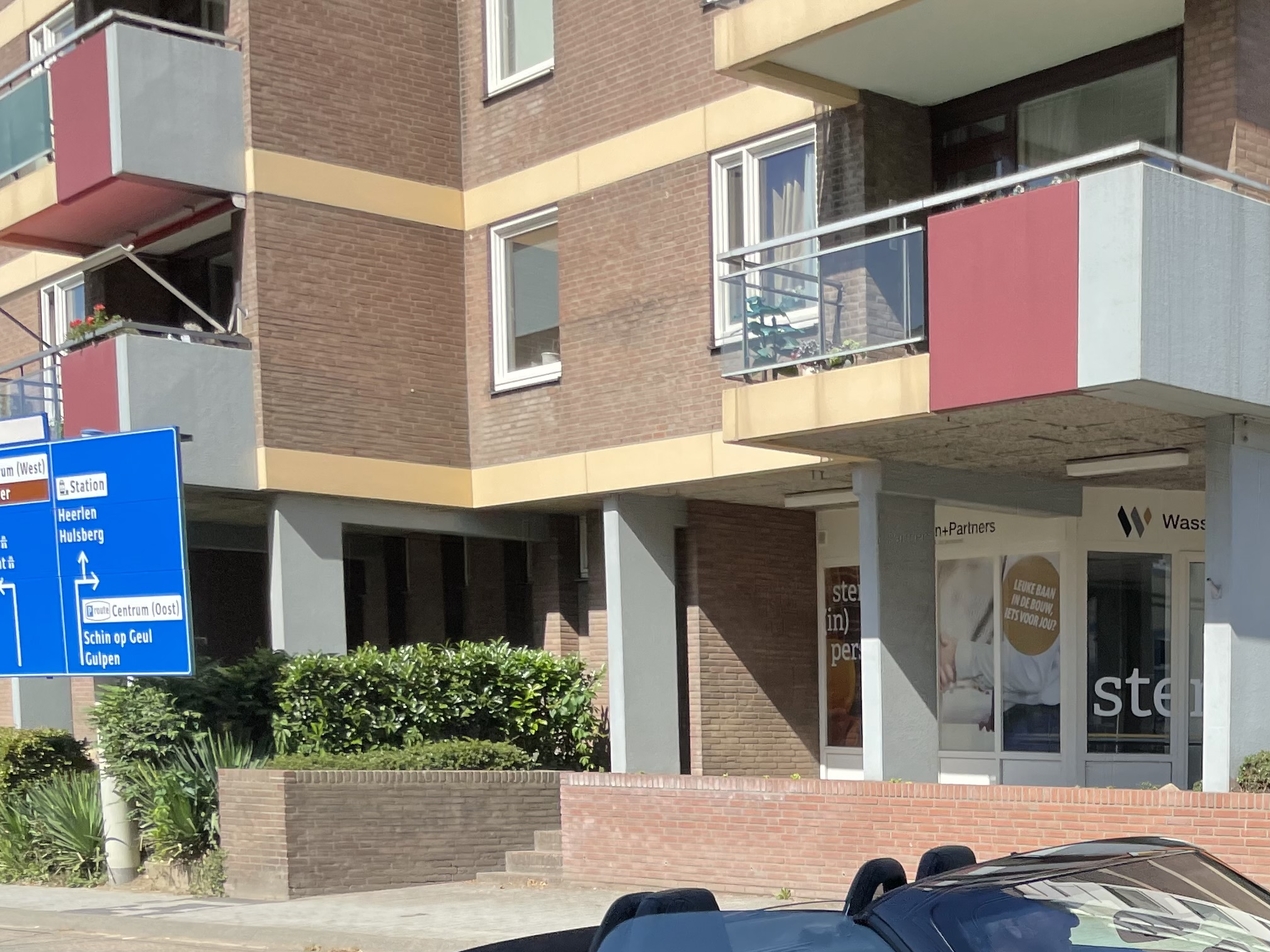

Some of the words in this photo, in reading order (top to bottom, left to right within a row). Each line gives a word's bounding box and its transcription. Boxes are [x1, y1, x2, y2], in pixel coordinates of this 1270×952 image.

[17, 459, 45, 477] (West)
[70, 478, 105, 493] Station
[57, 505, 98, 522] Heerlen
[59, 528, 105, 545] Hulsberg
[935, 521, 996, 537] n+Partners
[1014, 579, 1036, 595] LEUKE
[1035, 584, 1057, 600] BAAN
[94, 606, 110, 616] route
[112, 603, 149, 617] Centrum
[152, 600, 180, 617] (Oost)
[1011, 594, 1021, 606] IN
[1020, 596, 1031, 609] DE
[1030, 599, 1054, 617] BOUW,
[825, 607, 849, 635] in)
[1004, 607, 1020, 621] IETS
[1020, 611, 1039, 627] VOOR
[1039, 617, 1057, 631] JOU?
[84, 630, 111, 645] Schin
[114, 633, 127, 648] op
[129, 628, 153, 644] Geul
[85, 651, 121, 669] Gulpen
